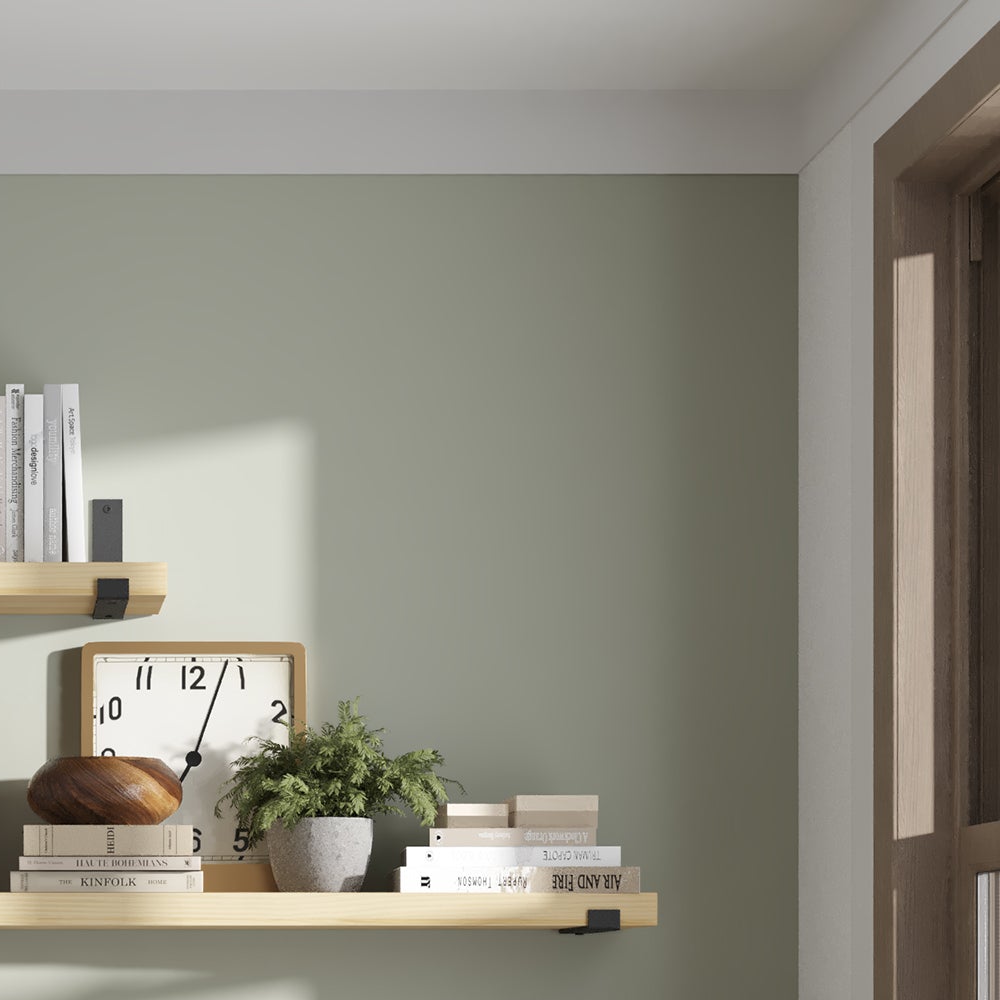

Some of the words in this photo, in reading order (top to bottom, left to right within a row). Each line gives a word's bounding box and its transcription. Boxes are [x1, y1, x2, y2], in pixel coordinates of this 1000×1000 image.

[11, 417, 22, 446] Fashion
[8, 447, 22, 504] Merchandising
[136, 666, 153, 690] 11
[181, 665, 206, 690] 12
[237, 665, 245, 690] 1
[100, 696, 122, 725] 10
[271, 700, 288, 724] 2
[106, 826, 115, 854] HEIDI
[232, 827, 250, 853] 5
[75, 859, 108, 868] HAUTE
[111, 859, 169, 868] BOHEMIANS
[542, 850, 571, 861] CAPOTE
[80, 877, 137, 887] KINFOLK
[457, 876, 492, 889] THOMSON
[498, 876, 528, 889] RUPERT
[551, 874, 574, 892] FIRE
[577, 874, 602, 890] AND
[603, 874, 622, 891] AIR
